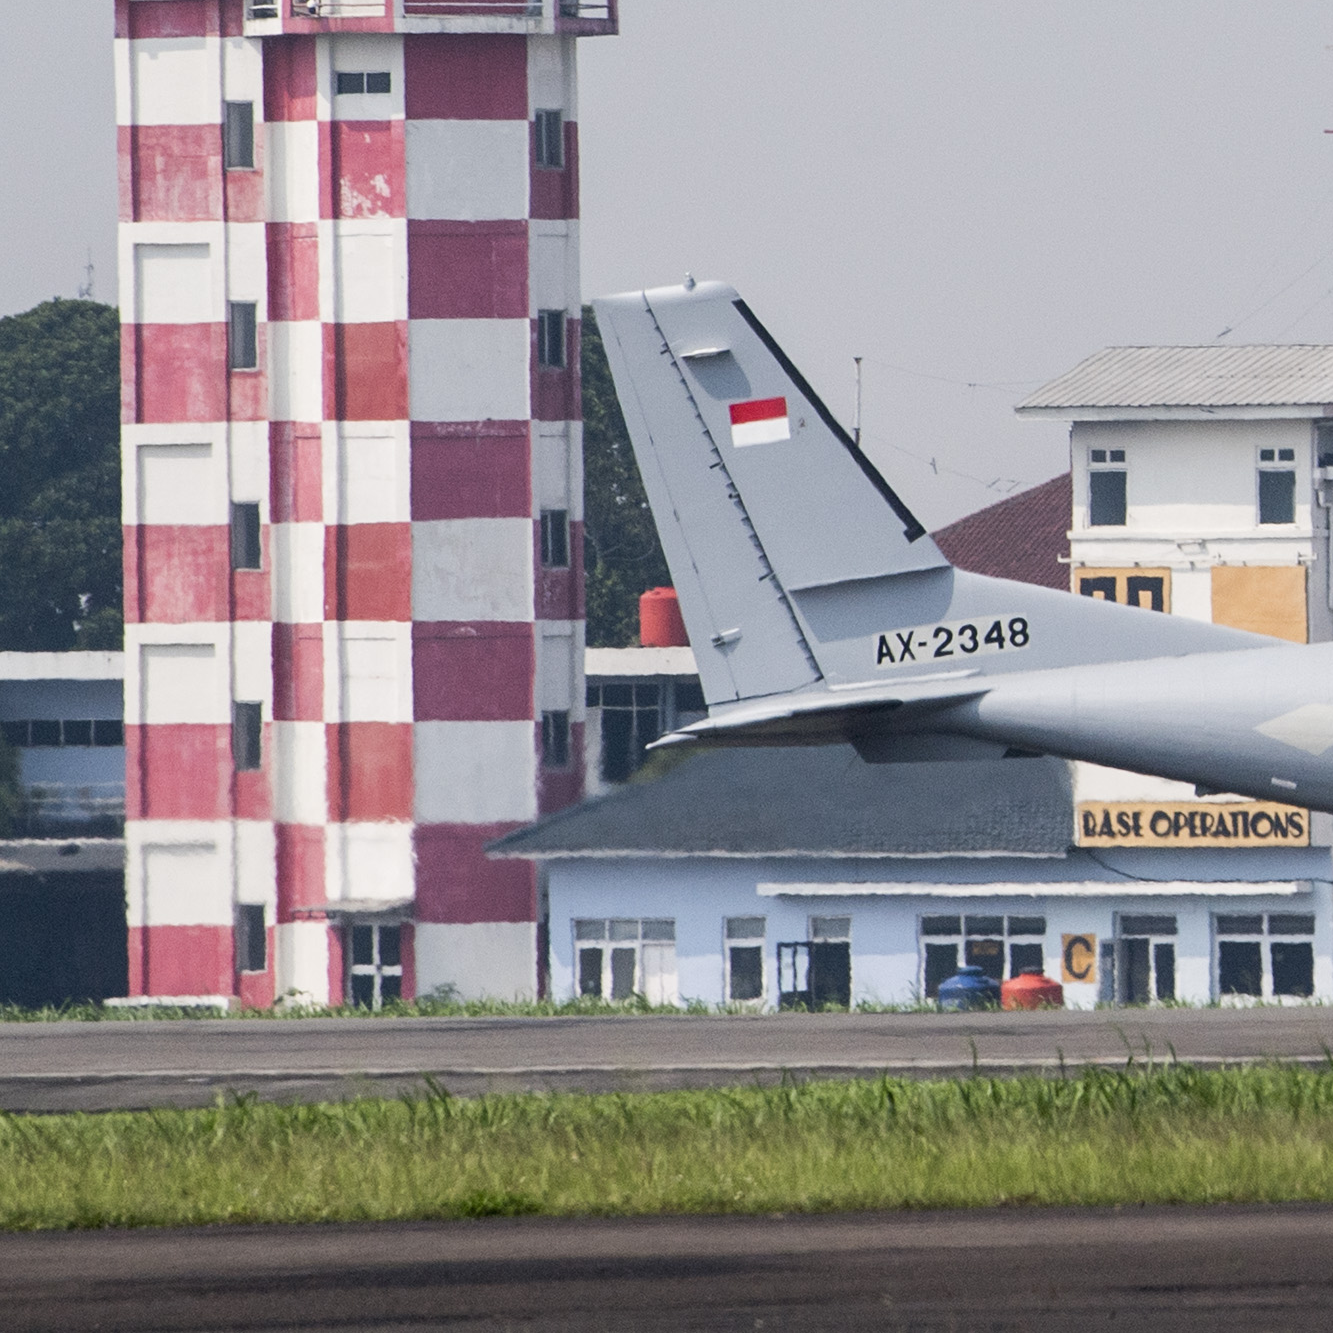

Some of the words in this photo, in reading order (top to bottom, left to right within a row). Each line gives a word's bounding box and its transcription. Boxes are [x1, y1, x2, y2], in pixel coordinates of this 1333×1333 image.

[876, 617, 1030, 665] AX-2348
[1082, 809, 1145, 838] BASE
[1149, 809, 1305, 839] OPERATIONS
[1064, 935, 1092, 980] C
